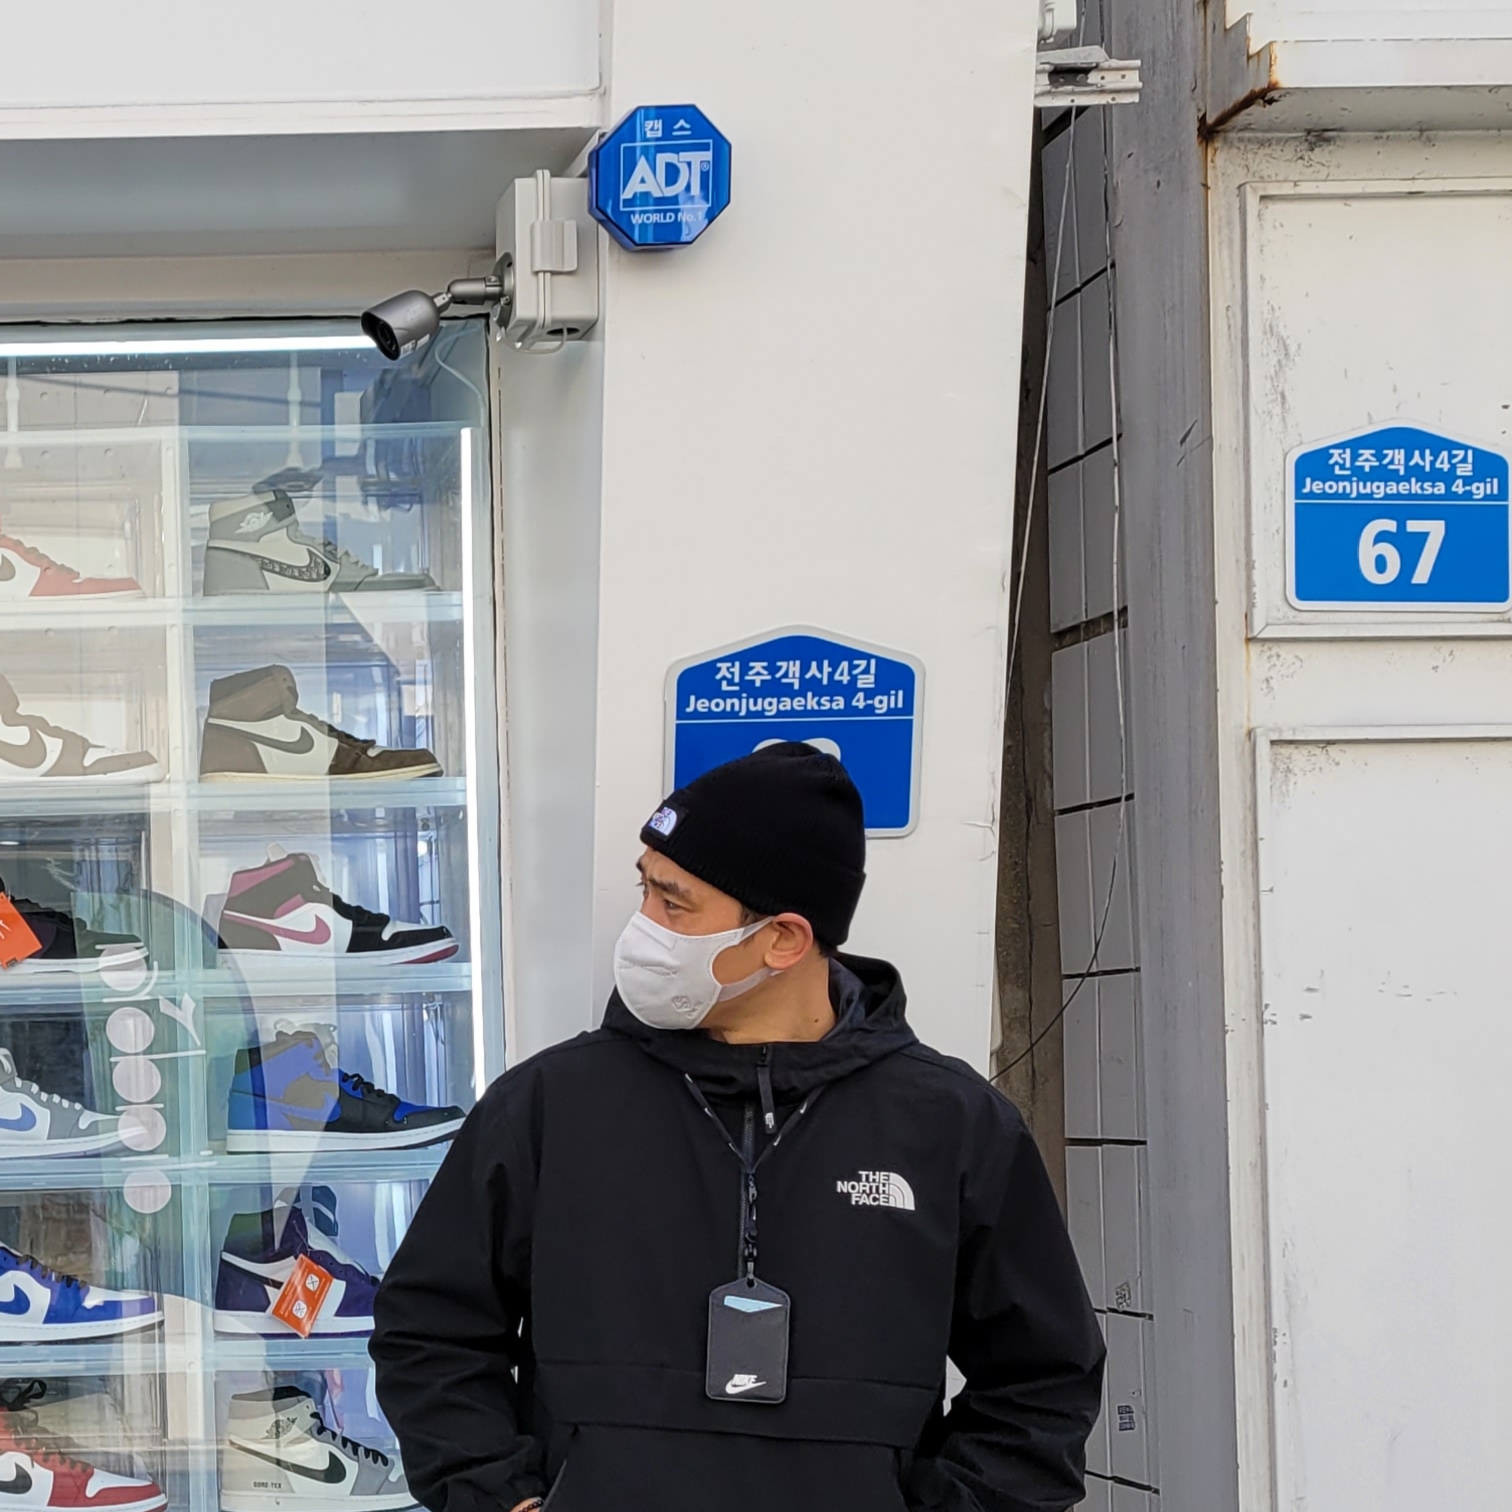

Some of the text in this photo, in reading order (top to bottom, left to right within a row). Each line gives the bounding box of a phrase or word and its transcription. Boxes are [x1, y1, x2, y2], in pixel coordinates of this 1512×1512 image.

[621, 151, 712, 200] ADT
[630, 212, 675, 225] WORLD
[1327, 447, 1475, 477] 전주객사4길
[1301, 476, 1500, 500] Jeonjugaeksa 4-gil
[1357, 518, 1446, 586] 67
[715, 658, 877, 692] 전주객사4길
[685, 690, 904, 717] Jeonjugaeksa 4-gil
[836, 1180, 890, 1195] NORTH
[857, 1171, 890, 1185] THE
[851, 1193, 890, 1207] FACE
